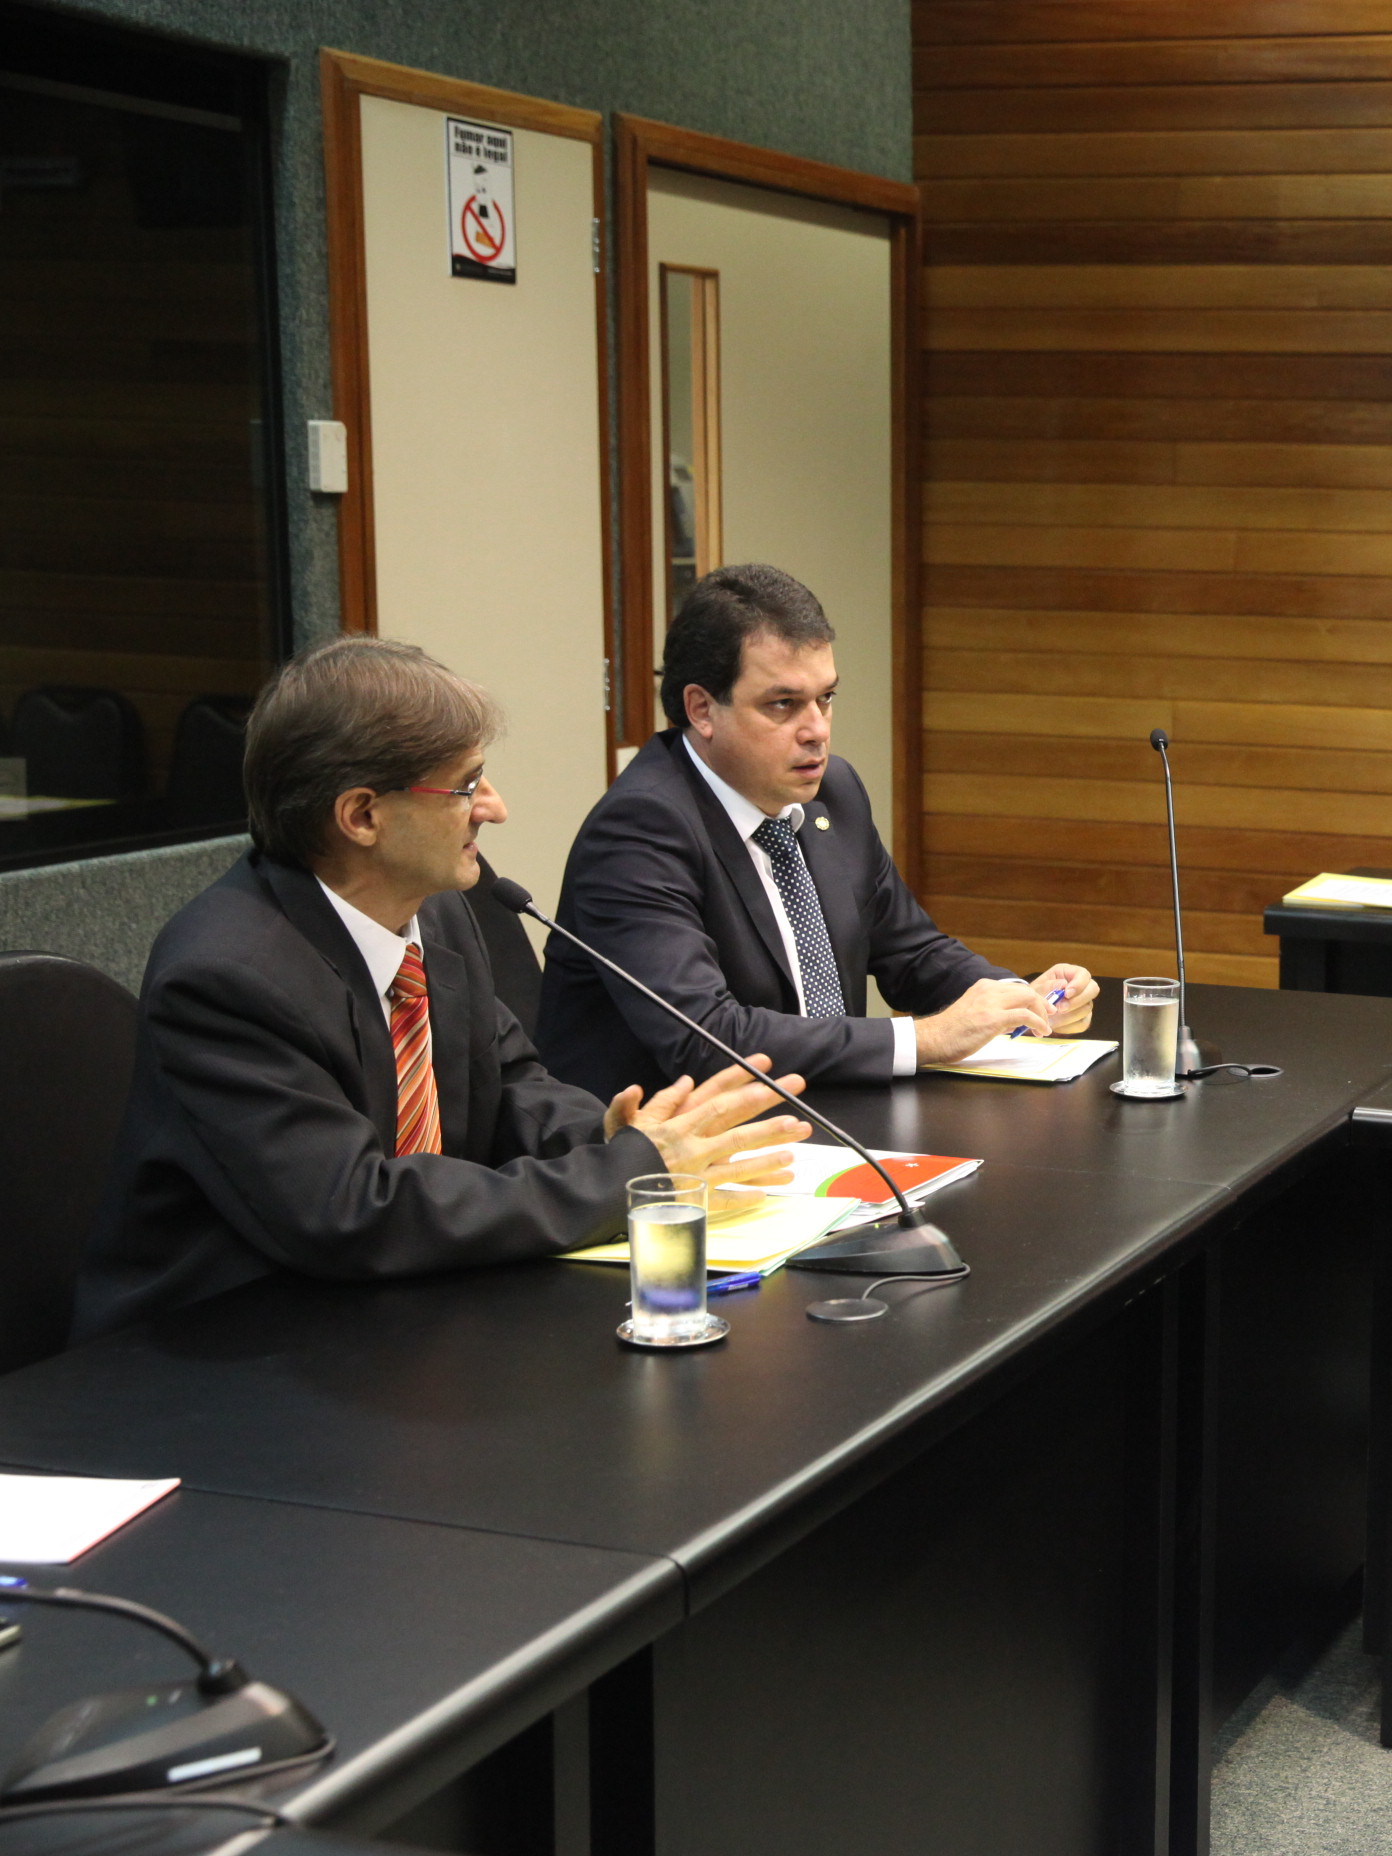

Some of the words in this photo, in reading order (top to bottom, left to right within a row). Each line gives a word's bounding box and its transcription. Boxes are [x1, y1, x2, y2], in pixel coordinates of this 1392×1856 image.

[455, 125, 484, 143] Fumar
[487, 136, 507, 148] aqui
[455, 142, 472, 154] não
[483, 147, 507, 162] legal
